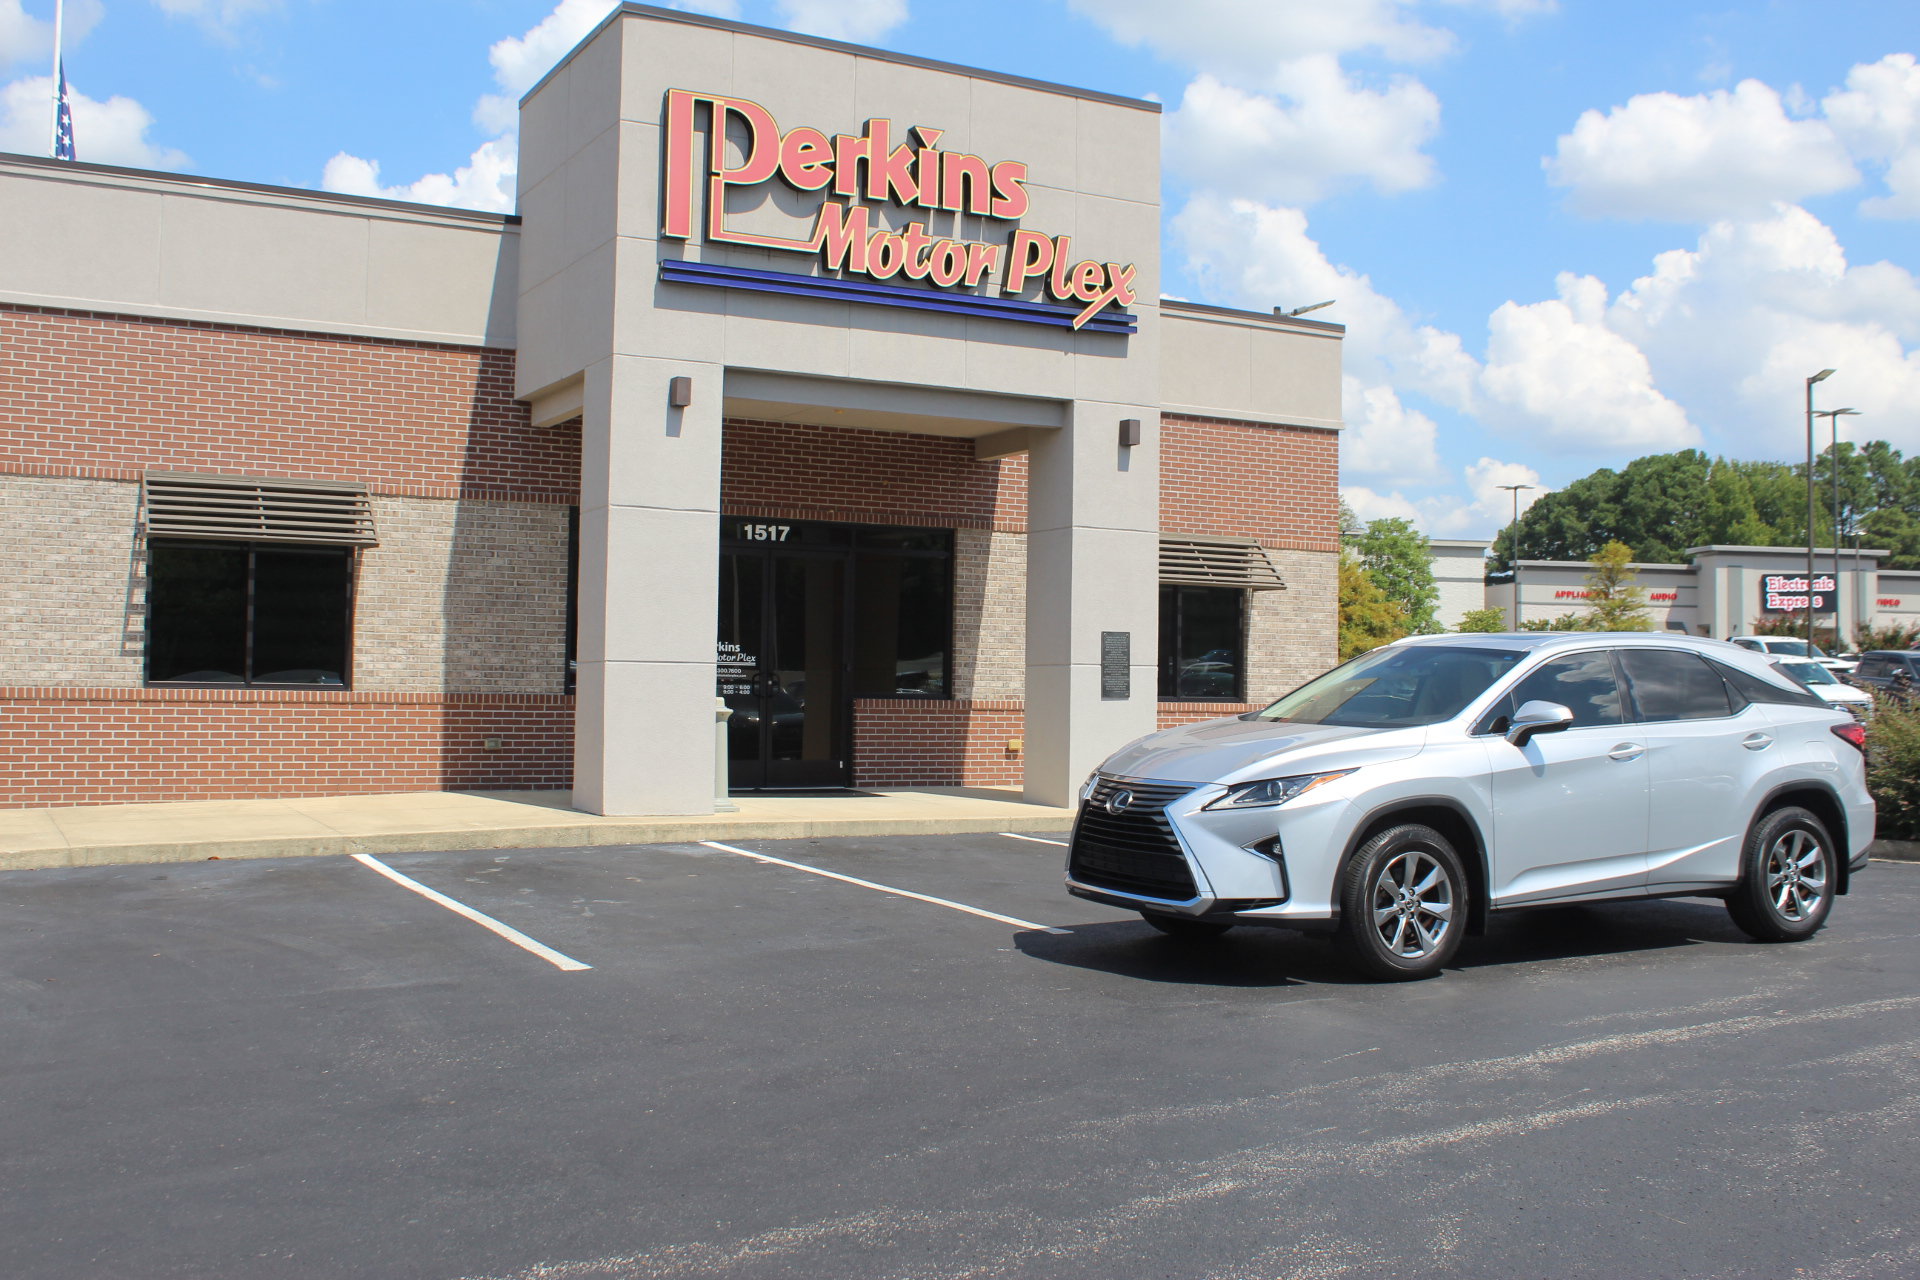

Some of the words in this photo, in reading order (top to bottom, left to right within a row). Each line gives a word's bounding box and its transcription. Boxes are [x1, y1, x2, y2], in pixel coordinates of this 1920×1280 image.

[664, 88, 1031, 240] Perkins
[812, 201, 999, 288] Motor
[1004, 229, 1138, 331] Plex
[744, 524, 790, 541] 1517
[1650, 593, 1678, 601] AUDIO
[1766, 593, 1823, 611] Expres
[717, 653, 736, 662] otor
[736, 652, 756, 663] Plex
